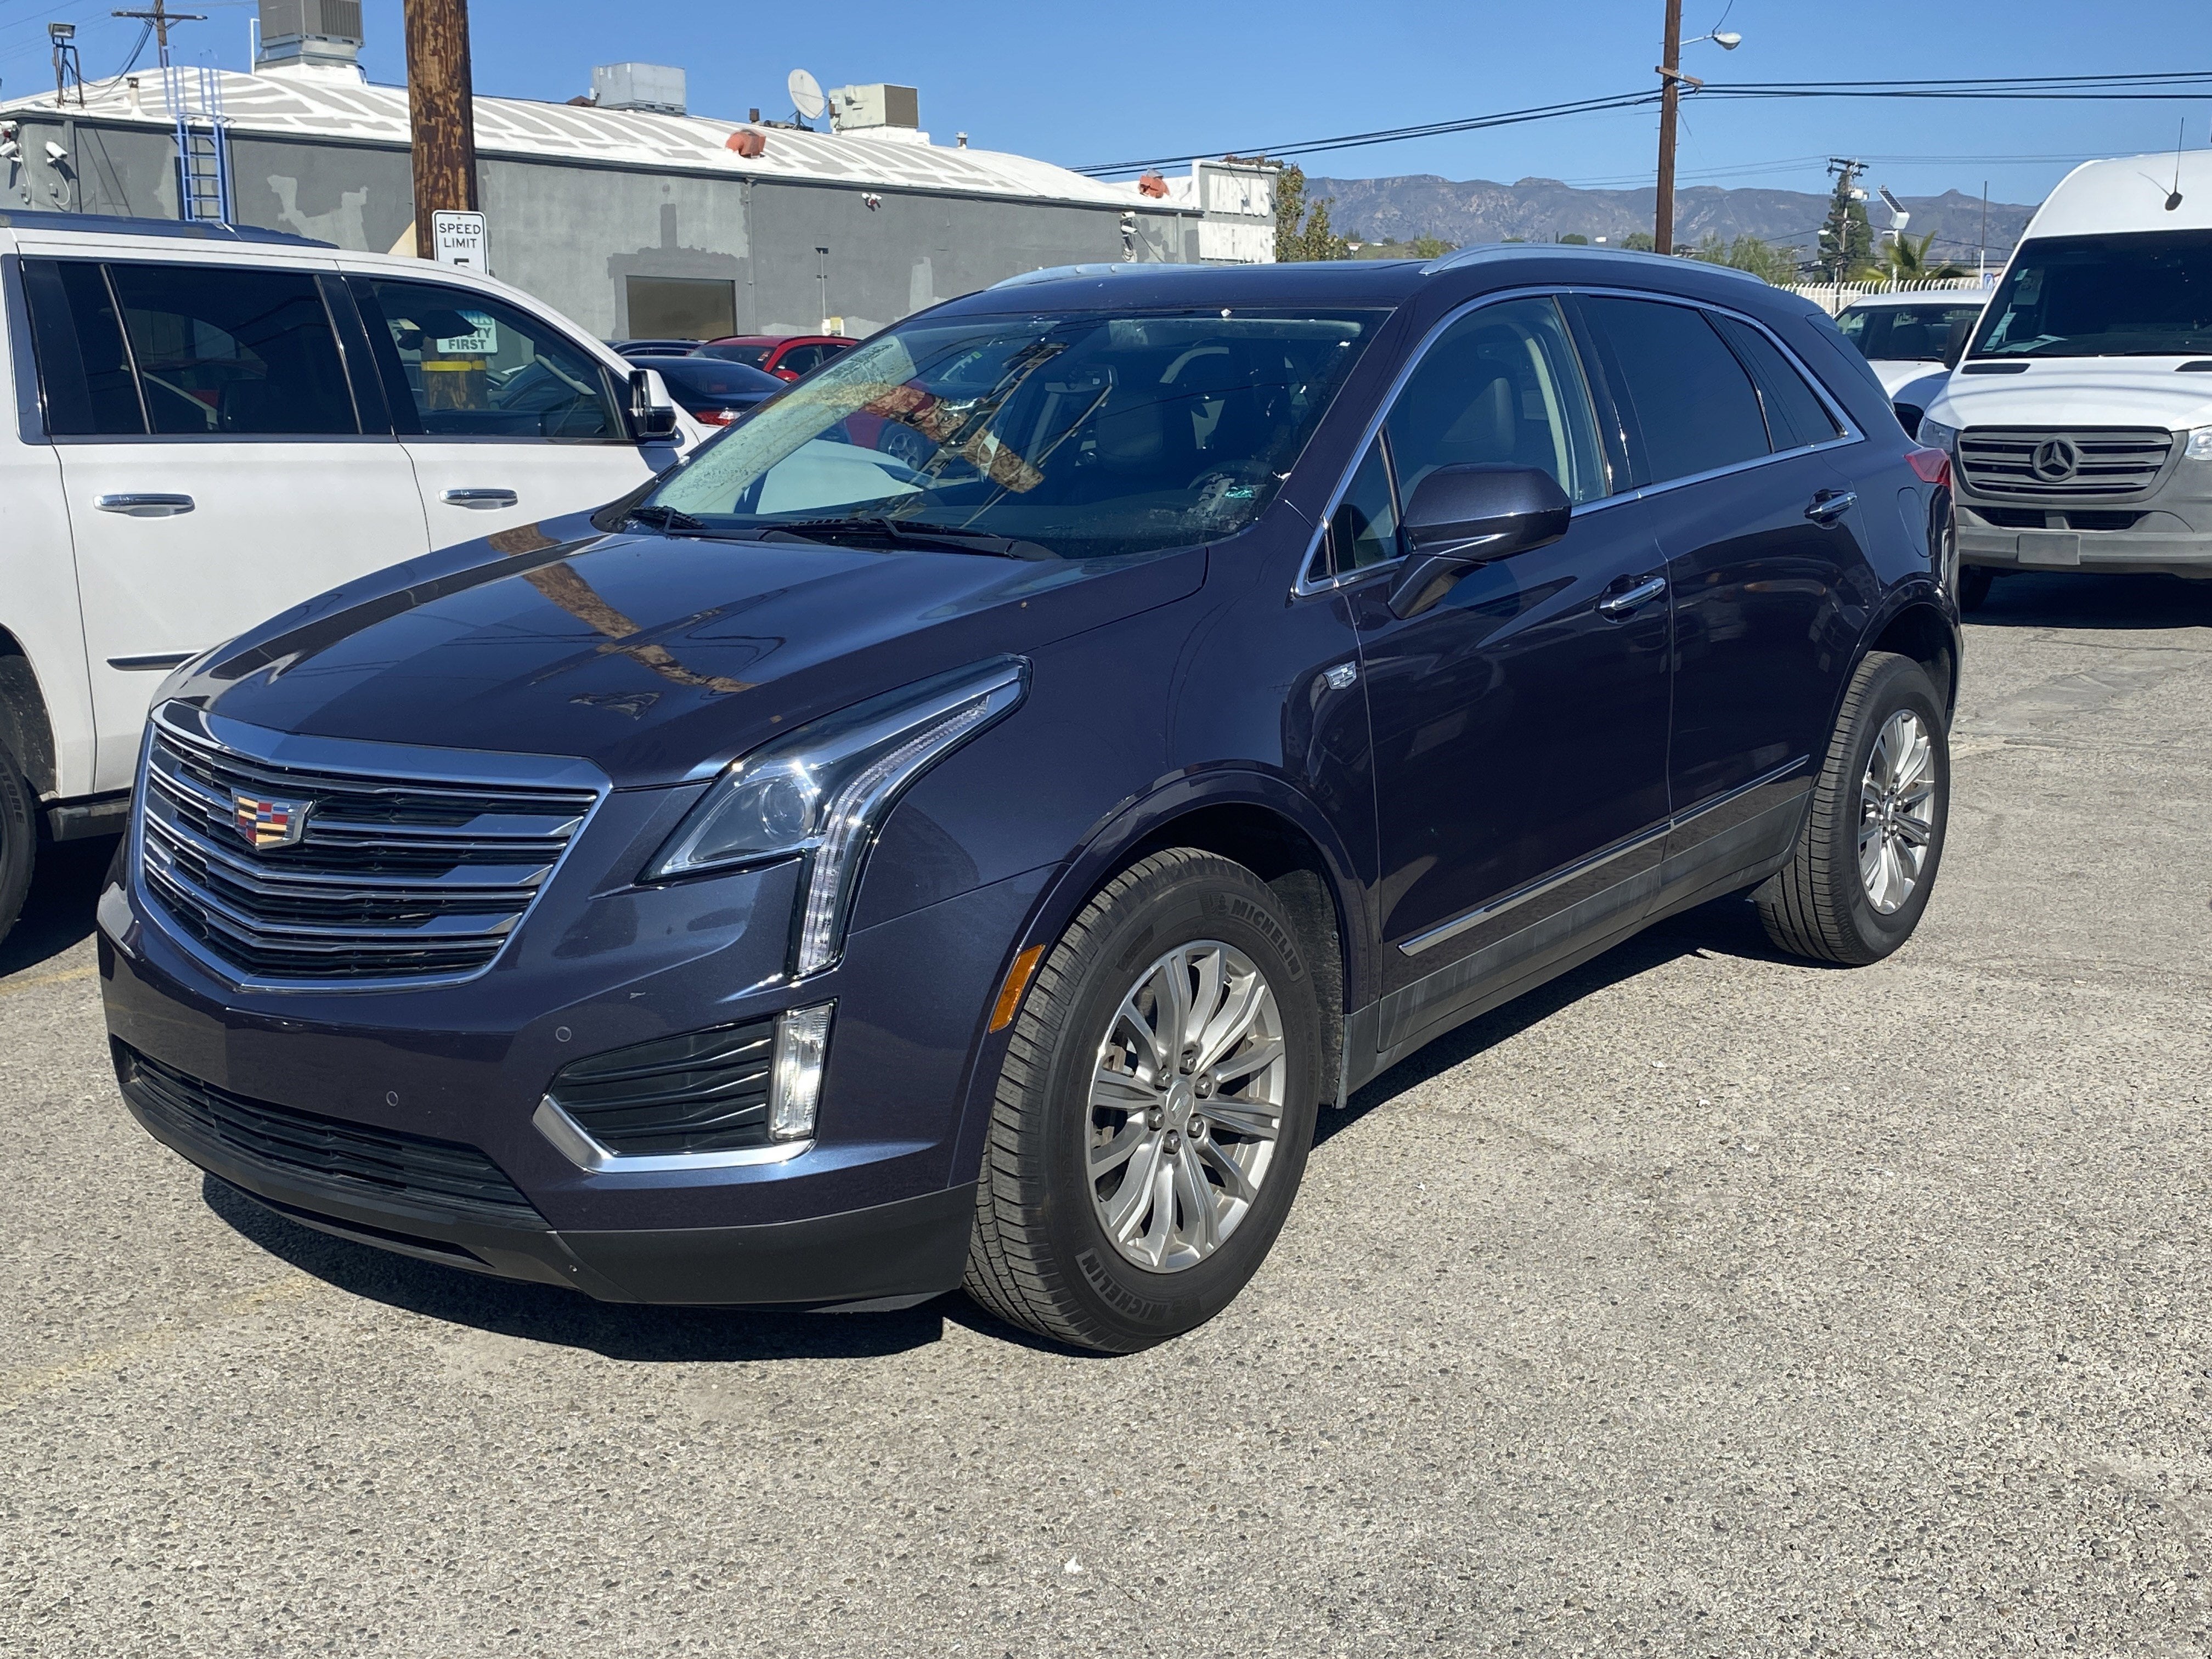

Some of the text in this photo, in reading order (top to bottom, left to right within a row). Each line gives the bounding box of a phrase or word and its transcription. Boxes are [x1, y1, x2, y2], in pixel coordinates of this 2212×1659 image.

[439, 223, 481, 235] SPEED
[444, 237, 477, 248] LIMIT
[448, 339, 487, 349] FIRST
[1230, 899, 1301, 975] MICHELIN
[1082, 1254, 1170, 1320] MICHELIN
